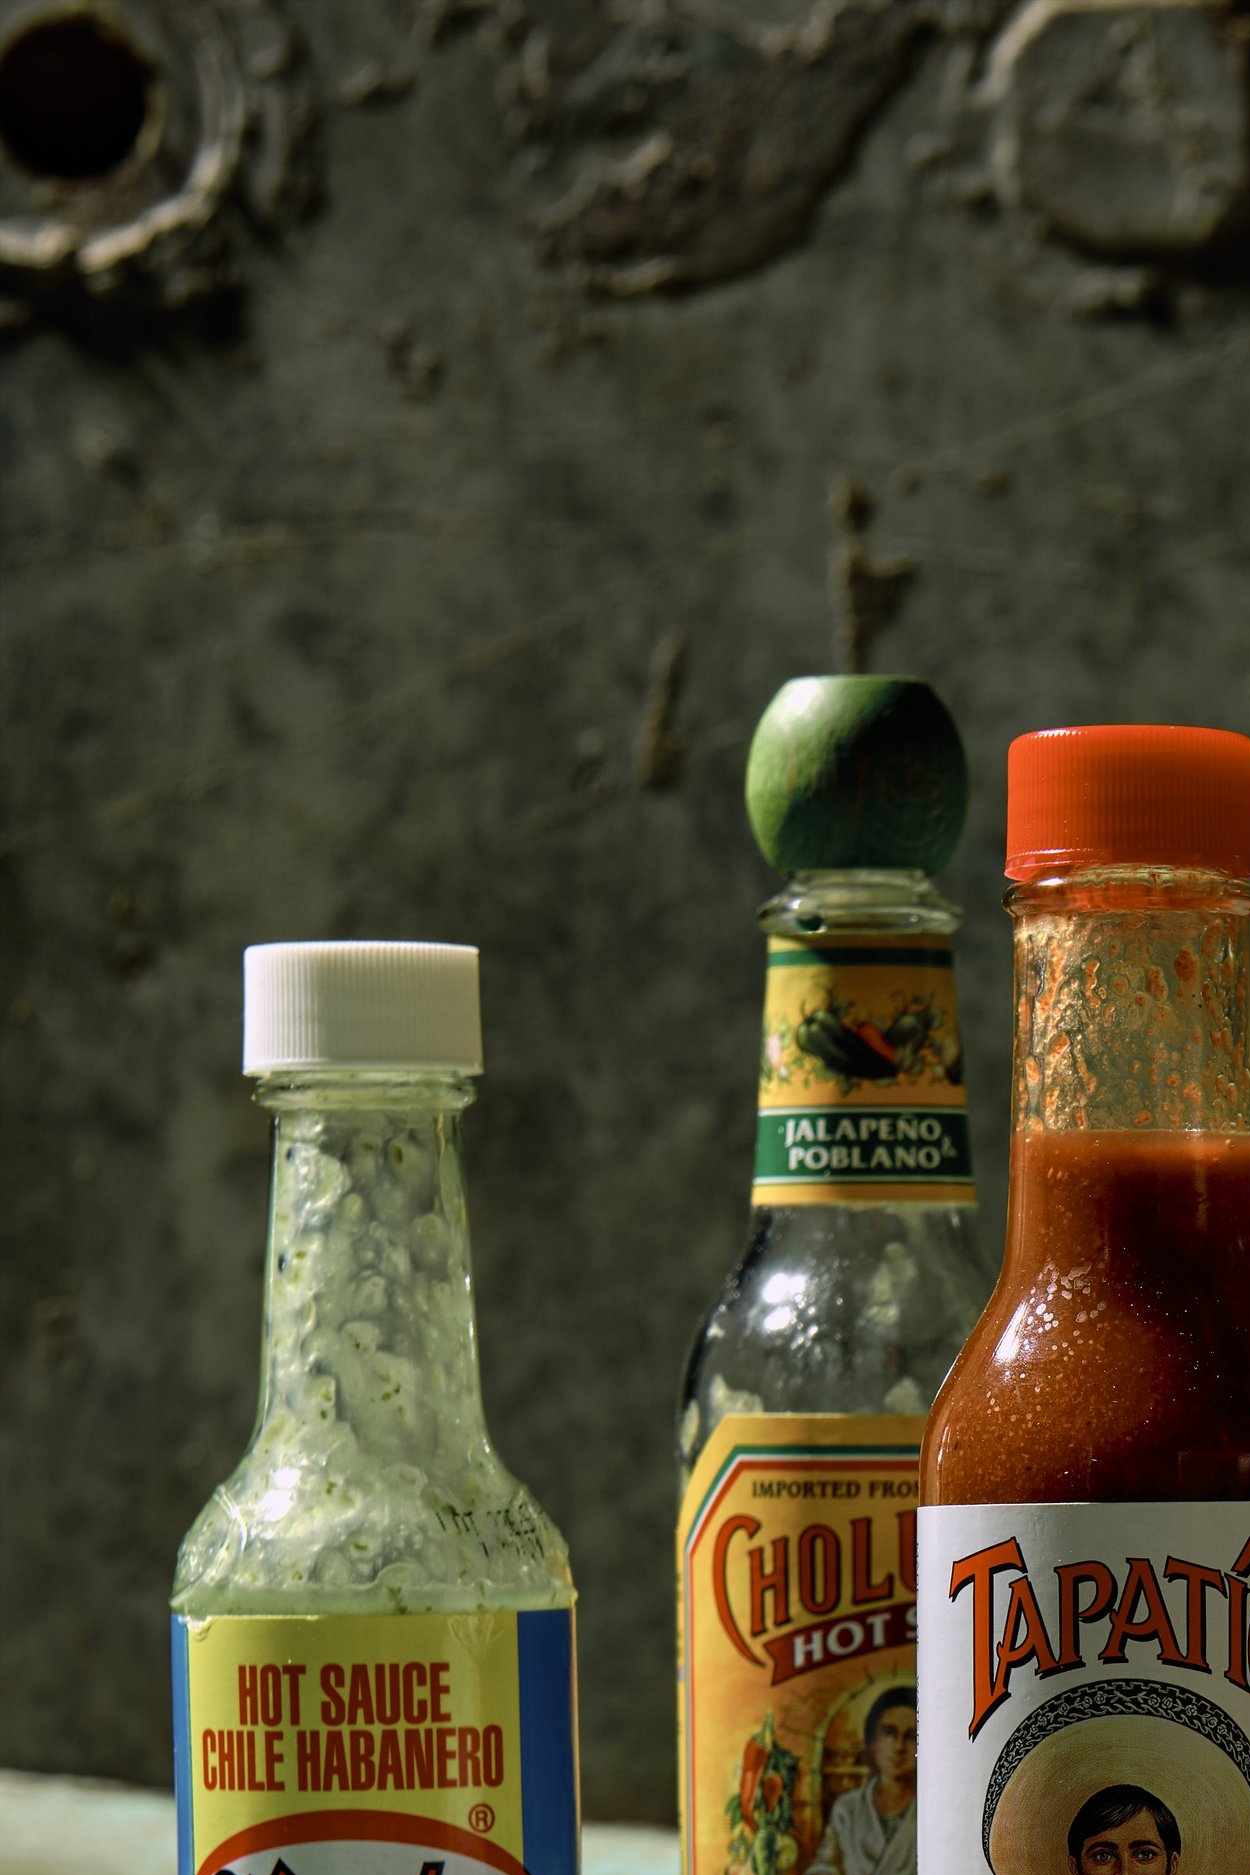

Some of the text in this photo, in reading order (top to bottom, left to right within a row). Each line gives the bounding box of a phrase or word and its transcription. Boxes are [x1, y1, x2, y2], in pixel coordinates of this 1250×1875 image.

[784, 1113, 942, 1148] JALAPEÑO
[788, 1146, 941, 1170] POBLANO
[752, 1479, 861, 1499] IMPORTED
[792, 1612, 891, 1668] HOT
[238, 1662, 452, 1726] HOT SAUCE
[202, 1724, 504, 1792] CHILE HABANERO
